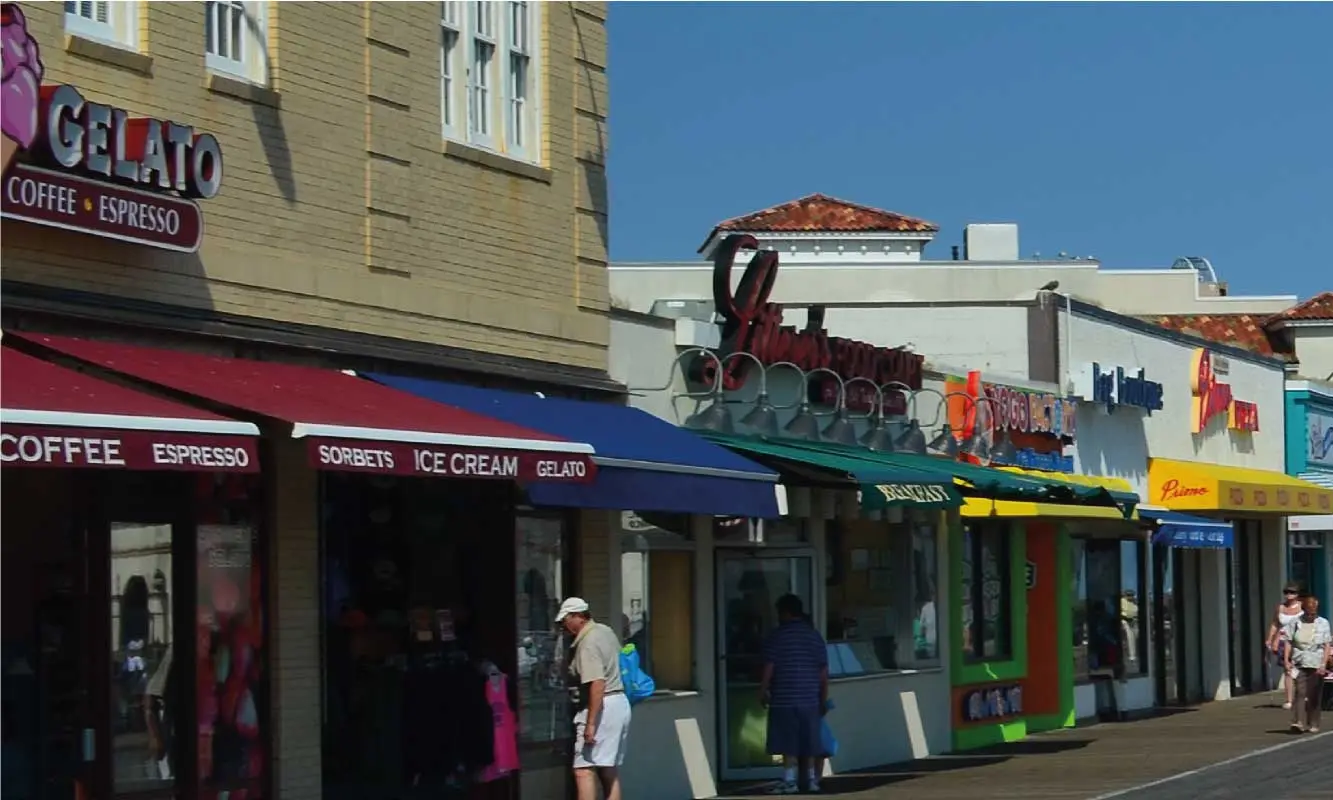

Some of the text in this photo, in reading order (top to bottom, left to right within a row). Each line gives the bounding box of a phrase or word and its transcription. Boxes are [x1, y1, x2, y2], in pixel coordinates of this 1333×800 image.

[48, 84, 224, 199] GELATO
[8, 176, 181, 236] COFFEE ESPRESSO
[0, 434, 249, 467] COFFEE ESPRESSO
[318, 445, 586, 478] SORBETS ICE CREAM GELATO
[1161, 479, 1209, 502] Primo
